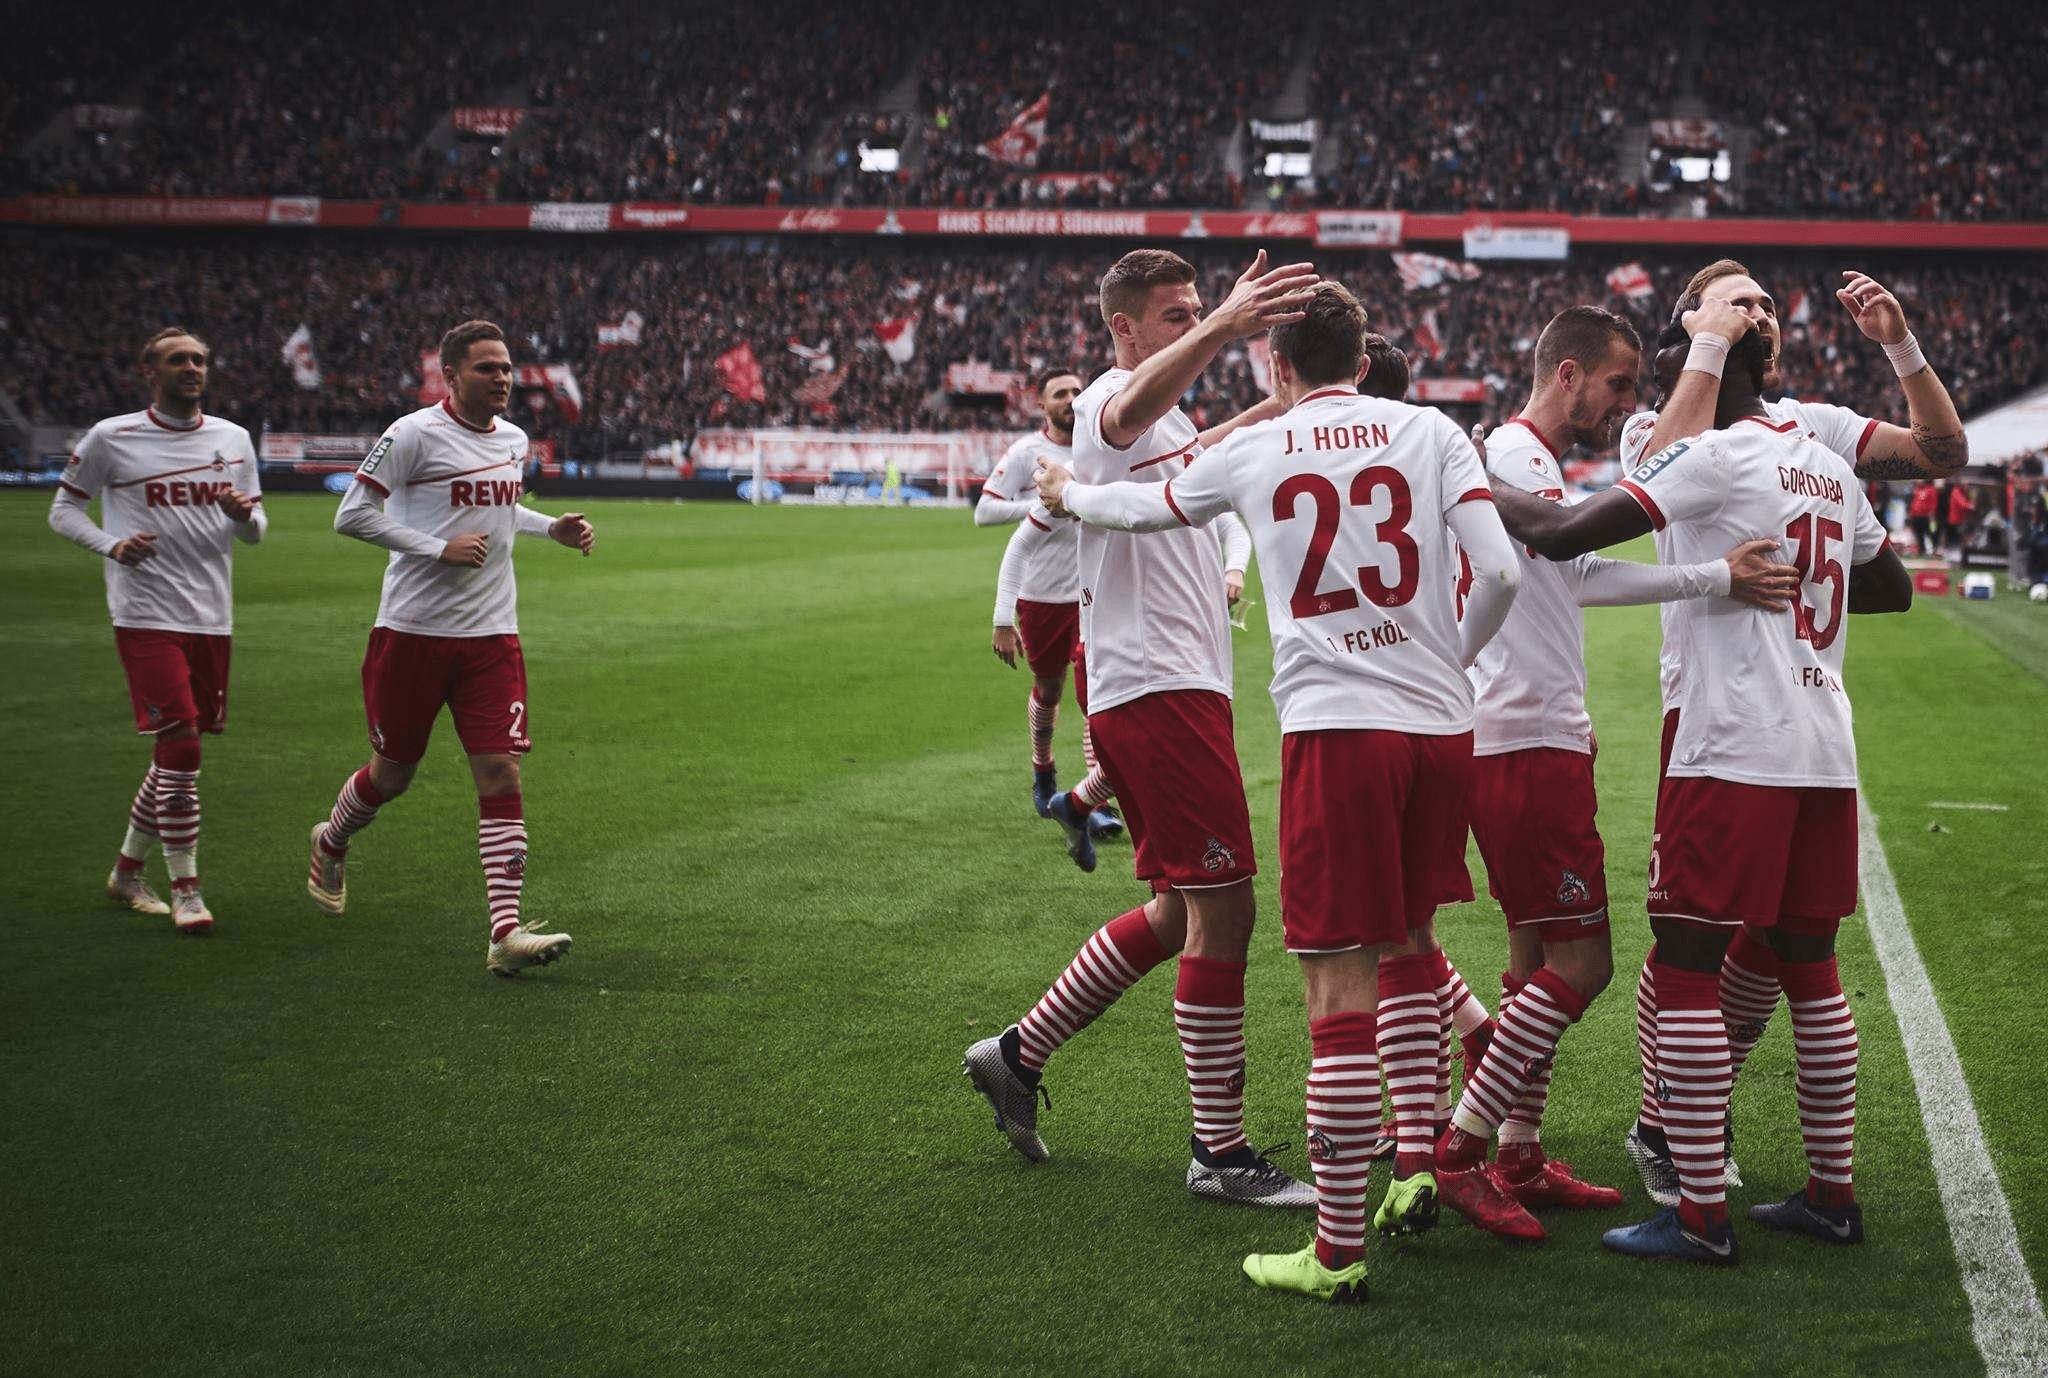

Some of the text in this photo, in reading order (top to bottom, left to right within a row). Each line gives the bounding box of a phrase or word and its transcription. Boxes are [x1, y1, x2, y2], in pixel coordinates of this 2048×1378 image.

[364, 439, 391, 472] DEVK
[1285, 423, 1390, 456] J. HORN
[1778, 466, 1844, 506] CORDOBA
[1272, 465, 1420, 620] 23
[1785, 512, 1845, 651] 15
[1343, 630, 1370, 654] FC
[1371, 619, 1411, 649] KÖL
[1802, 667, 1823, 688] FC
[509, 701, 524, 739] 2
